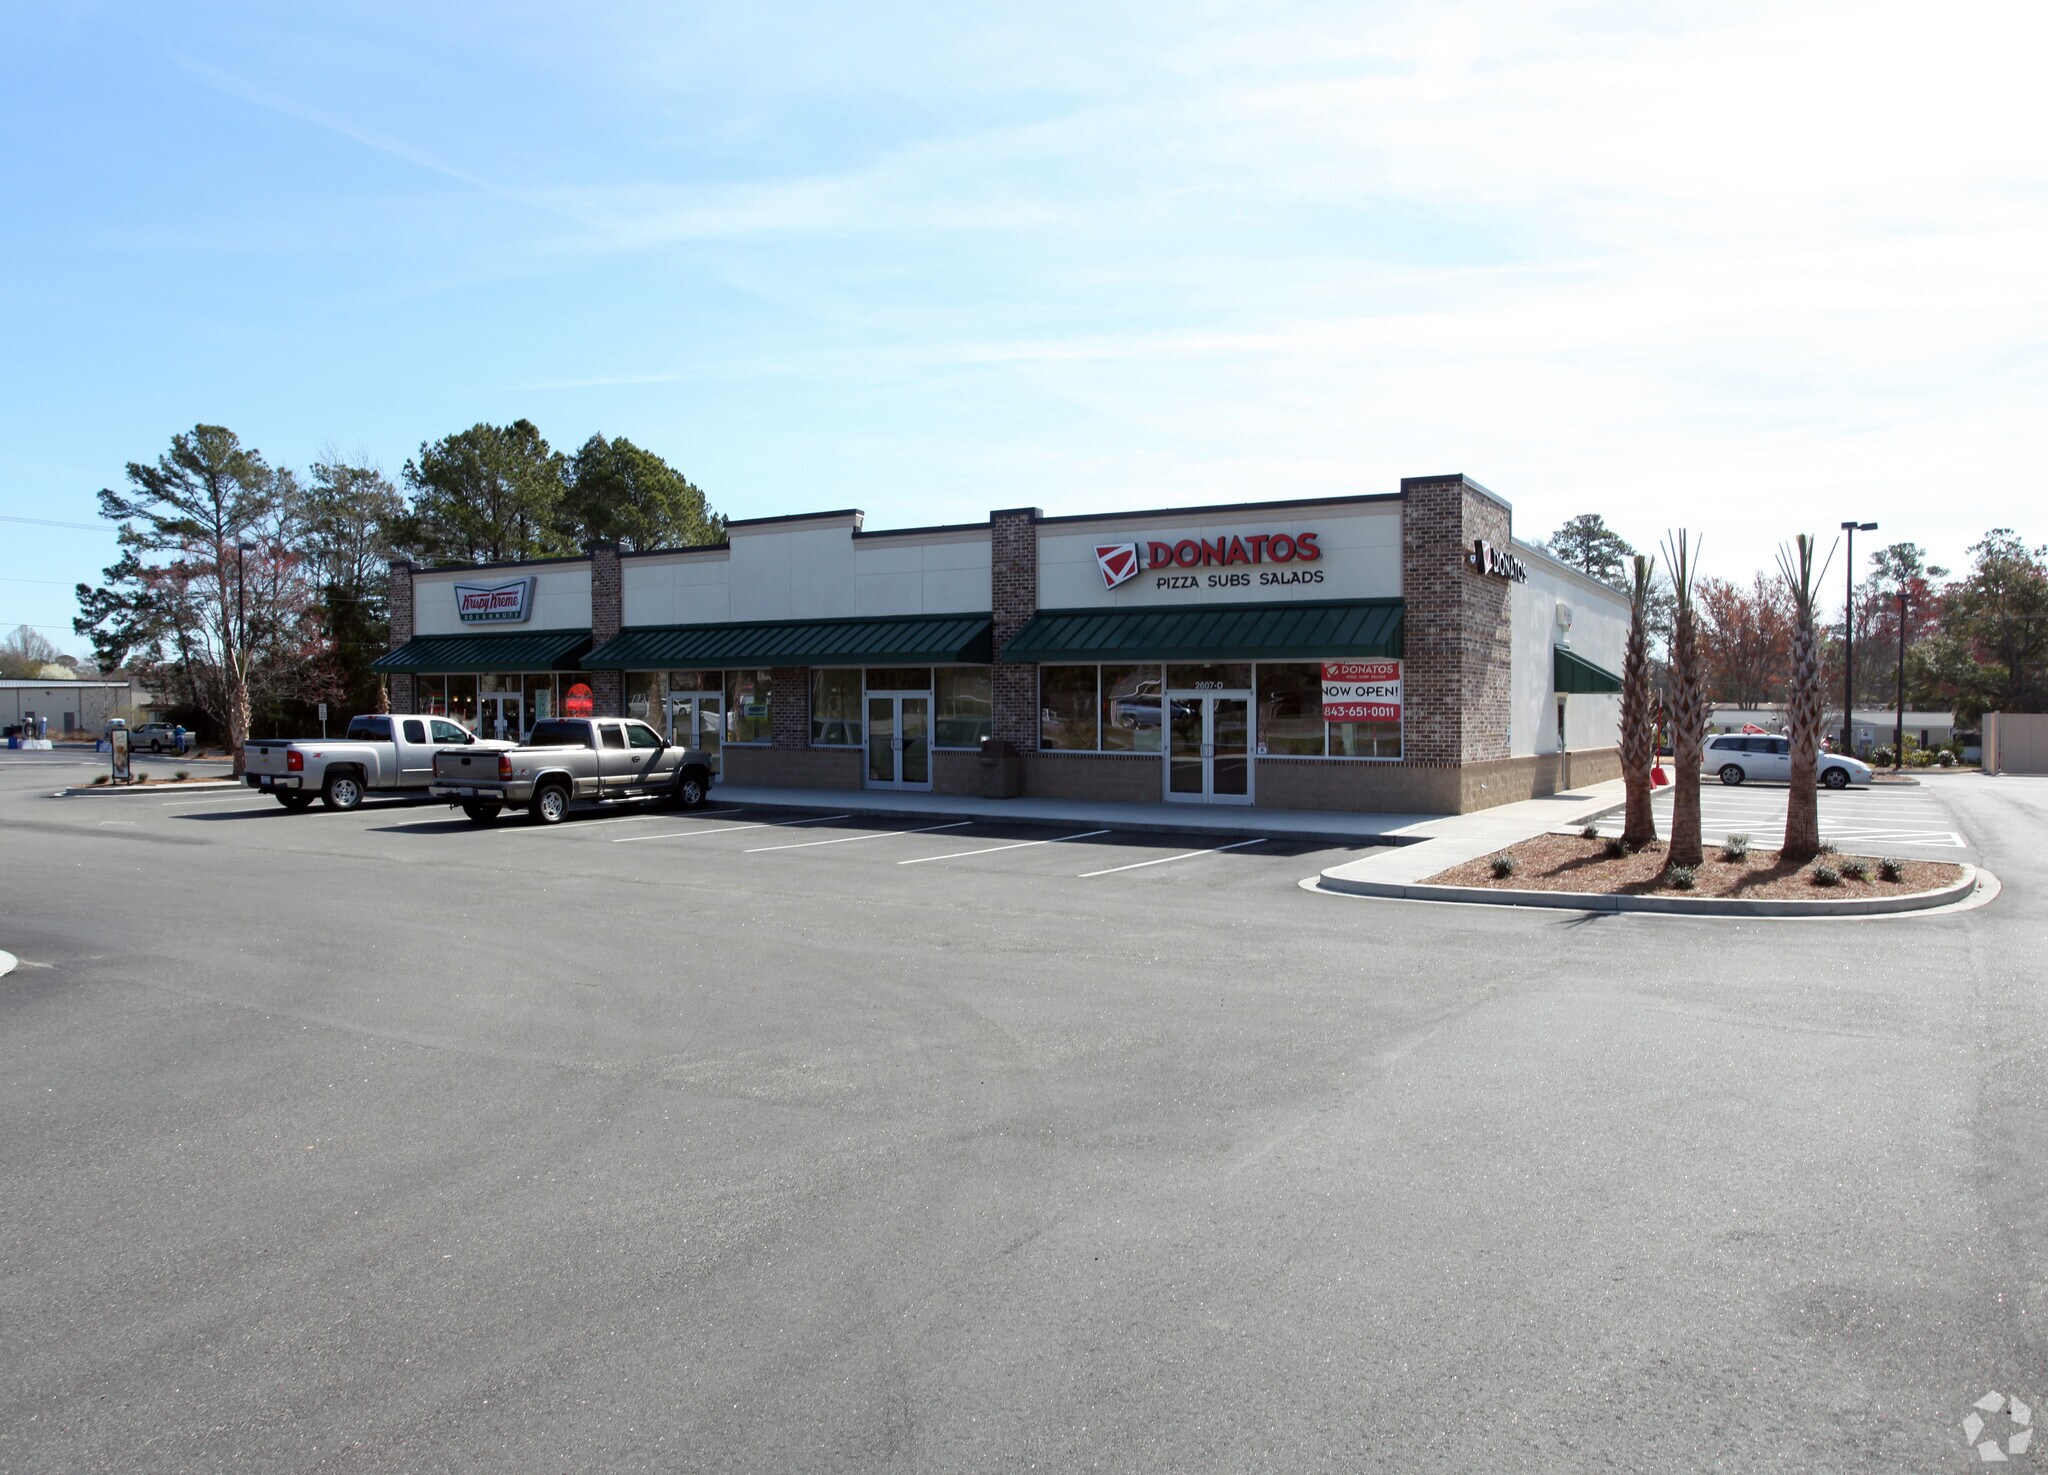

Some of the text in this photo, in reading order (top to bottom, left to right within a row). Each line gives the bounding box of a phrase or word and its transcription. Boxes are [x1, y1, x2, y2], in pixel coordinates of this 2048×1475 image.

[1146, 532, 1321, 569] DONATOS
[1491, 548, 1528, 584] DONATOS
[1156, 570, 1324, 590] PIZZA SUBS SALADS
[462, 590, 519, 612] Krispy Kreme
[464, 612, 519, 620] DOUGHNUTS
[1341, 665, 1394, 674] DONATOS
[1195, 681, 1223, 689] 2607-D
[1322, 686, 1398, 697] NOW OPEN!
[1324, 706, 1394, 717] 843-651-0011
